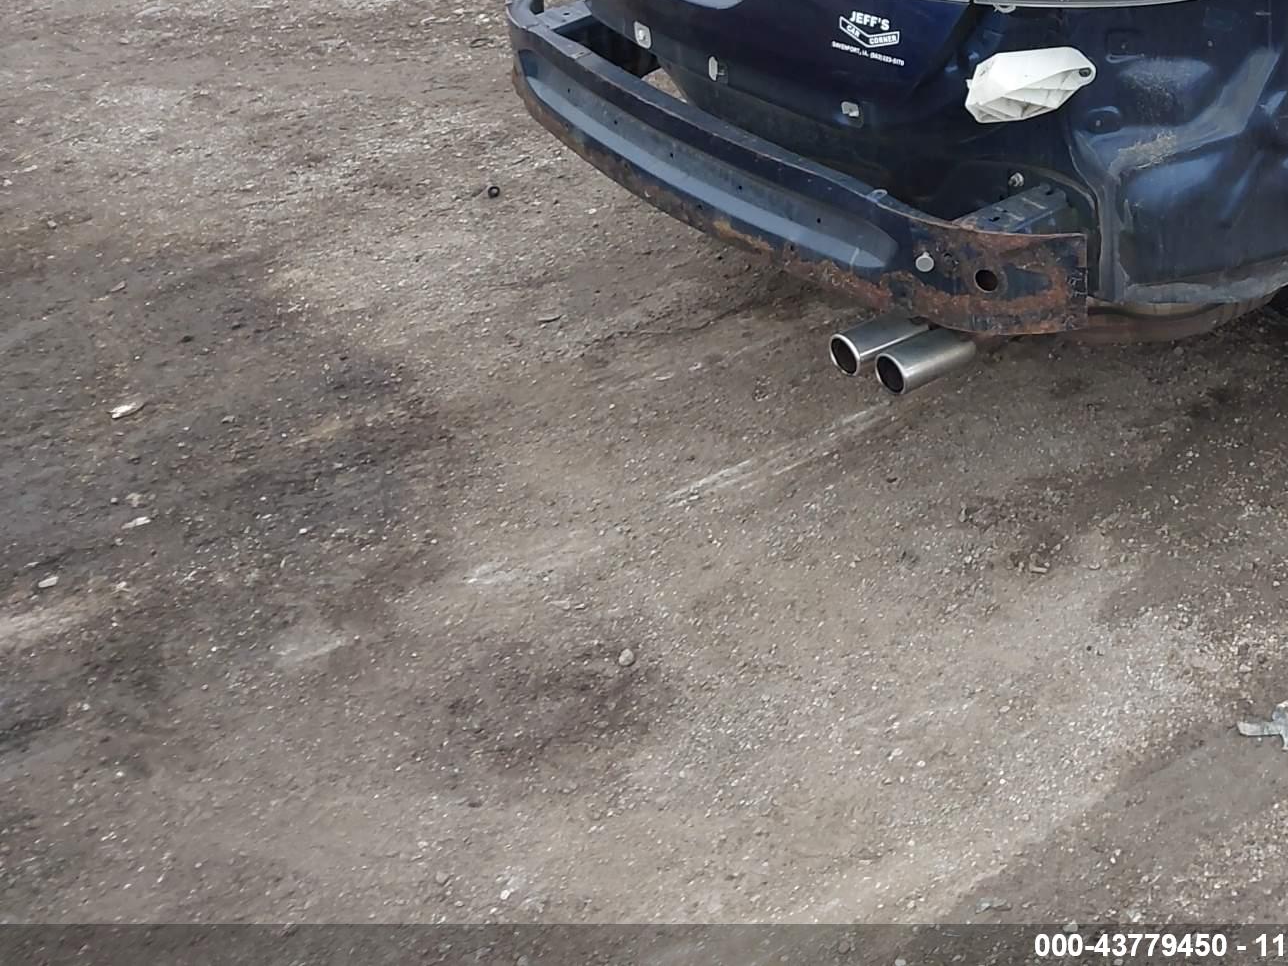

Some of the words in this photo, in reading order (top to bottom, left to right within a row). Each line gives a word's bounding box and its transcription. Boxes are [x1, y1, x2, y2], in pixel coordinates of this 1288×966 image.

[849, 10, 890, 31] JEFF'S
[846, 23, 861, 38] CAR
[868, 34, 897, 45] CORNER
